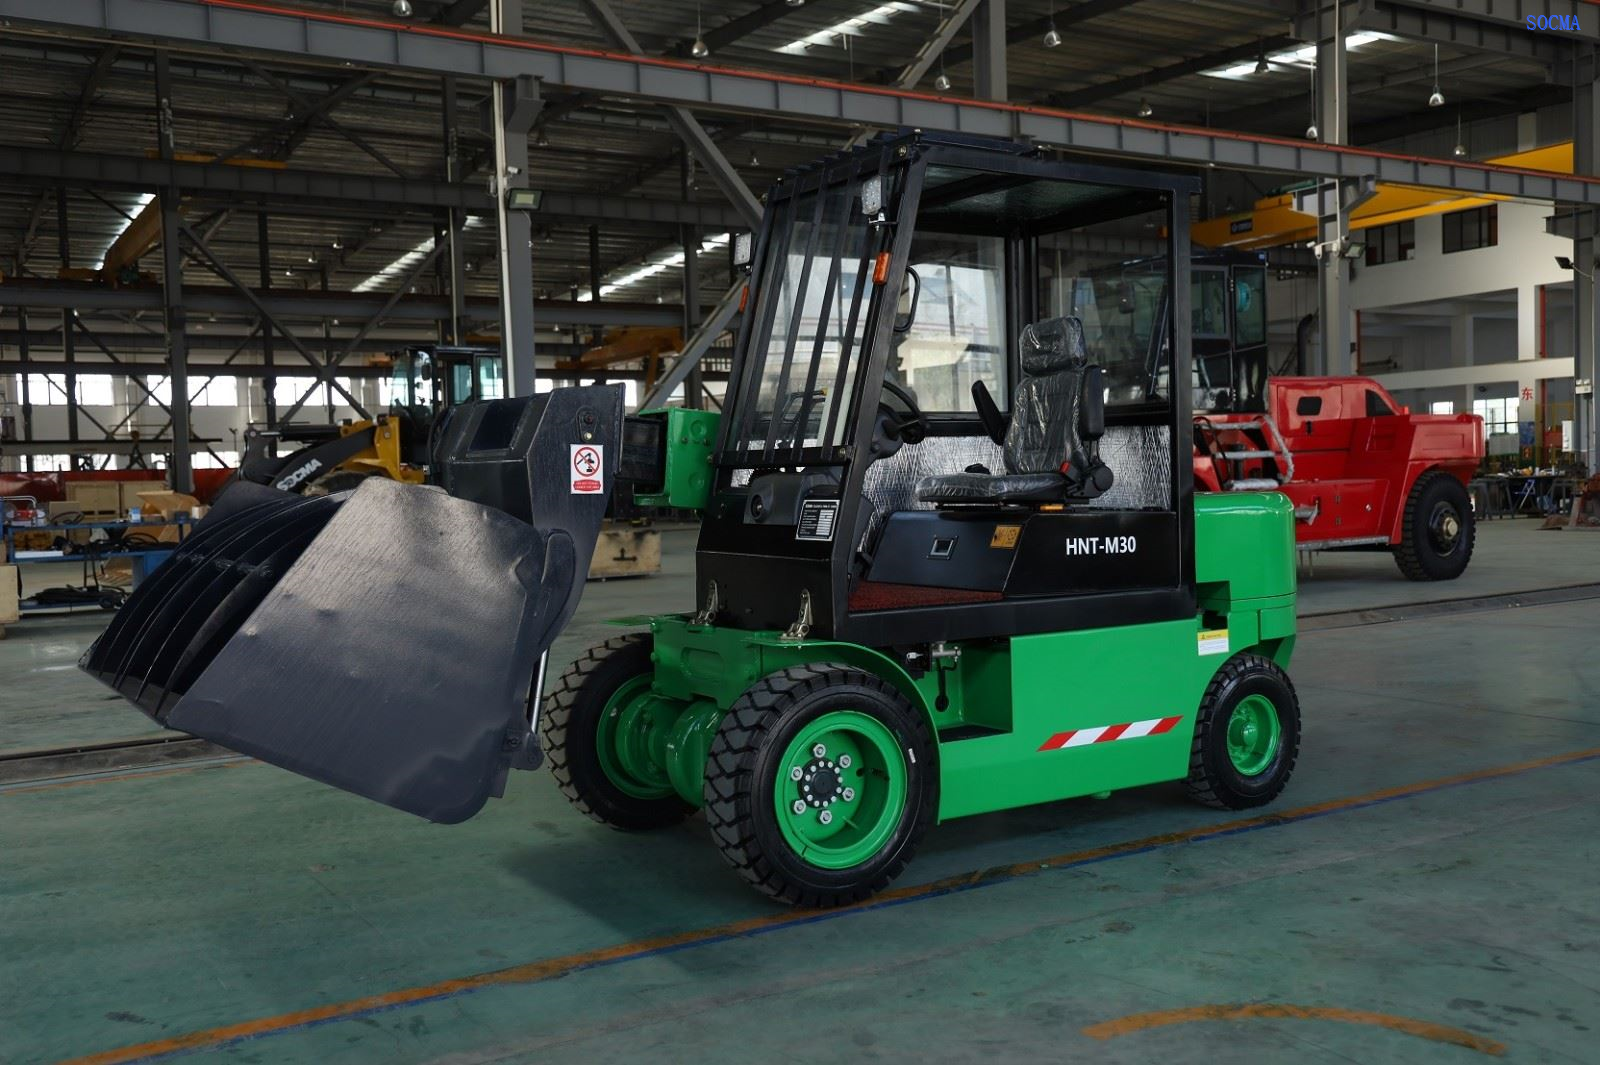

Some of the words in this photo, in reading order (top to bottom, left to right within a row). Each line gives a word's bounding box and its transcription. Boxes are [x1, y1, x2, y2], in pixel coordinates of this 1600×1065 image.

[1521, 387, 1534, 401] 东
[276, 458, 322, 491] SOCMA
[1066, 536, 1136, 555] HNT-M30
